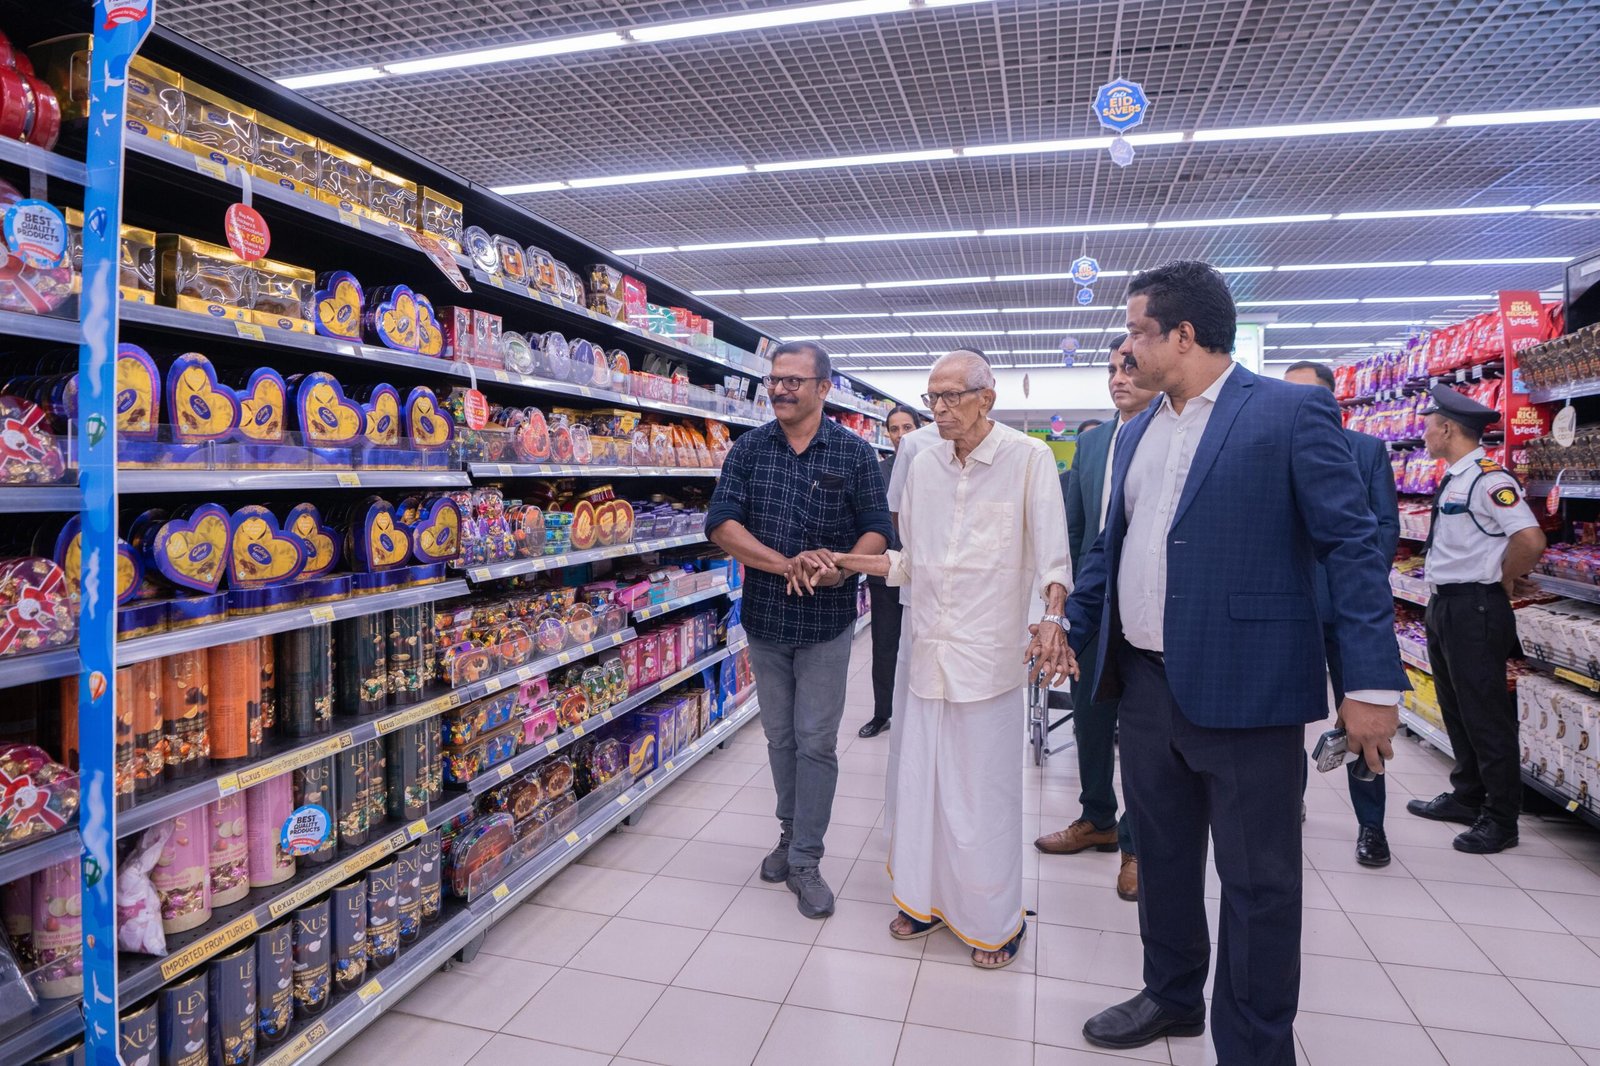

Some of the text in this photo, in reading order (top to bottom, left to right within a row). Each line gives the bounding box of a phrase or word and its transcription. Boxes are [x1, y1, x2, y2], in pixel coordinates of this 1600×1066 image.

[1110, 97, 1133, 107] EID
[1103, 104, 1141, 116] SAVERS
[25, 213, 52, 226] BEST
[21, 221, 55, 235] QUALITY
[17, 228, 59, 242] PRODUCTS
[1510, 316, 1539, 327] break
[1517, 411, 1538, 419] RICH
[1513, 425, 1543, 435] break
[381, 720, 394, 731] Lexus
[241, 771, 260, 784] Lexus
[300, 765, 329, 785] XUS
[296, 815, 317, 824] BEST
[290, 827, 321, 835] PRODUCTS
[293, 822, 318, 830] QUALITY
[271, 897, 296, 914] Lexus
[316, 871, 345, 889] Strawberry
[344, 860, 361, 873] Choco
[299, 913, 328, 935] XUS
[163, 918, 254, 976] IMPORTED FROM TURKEY
